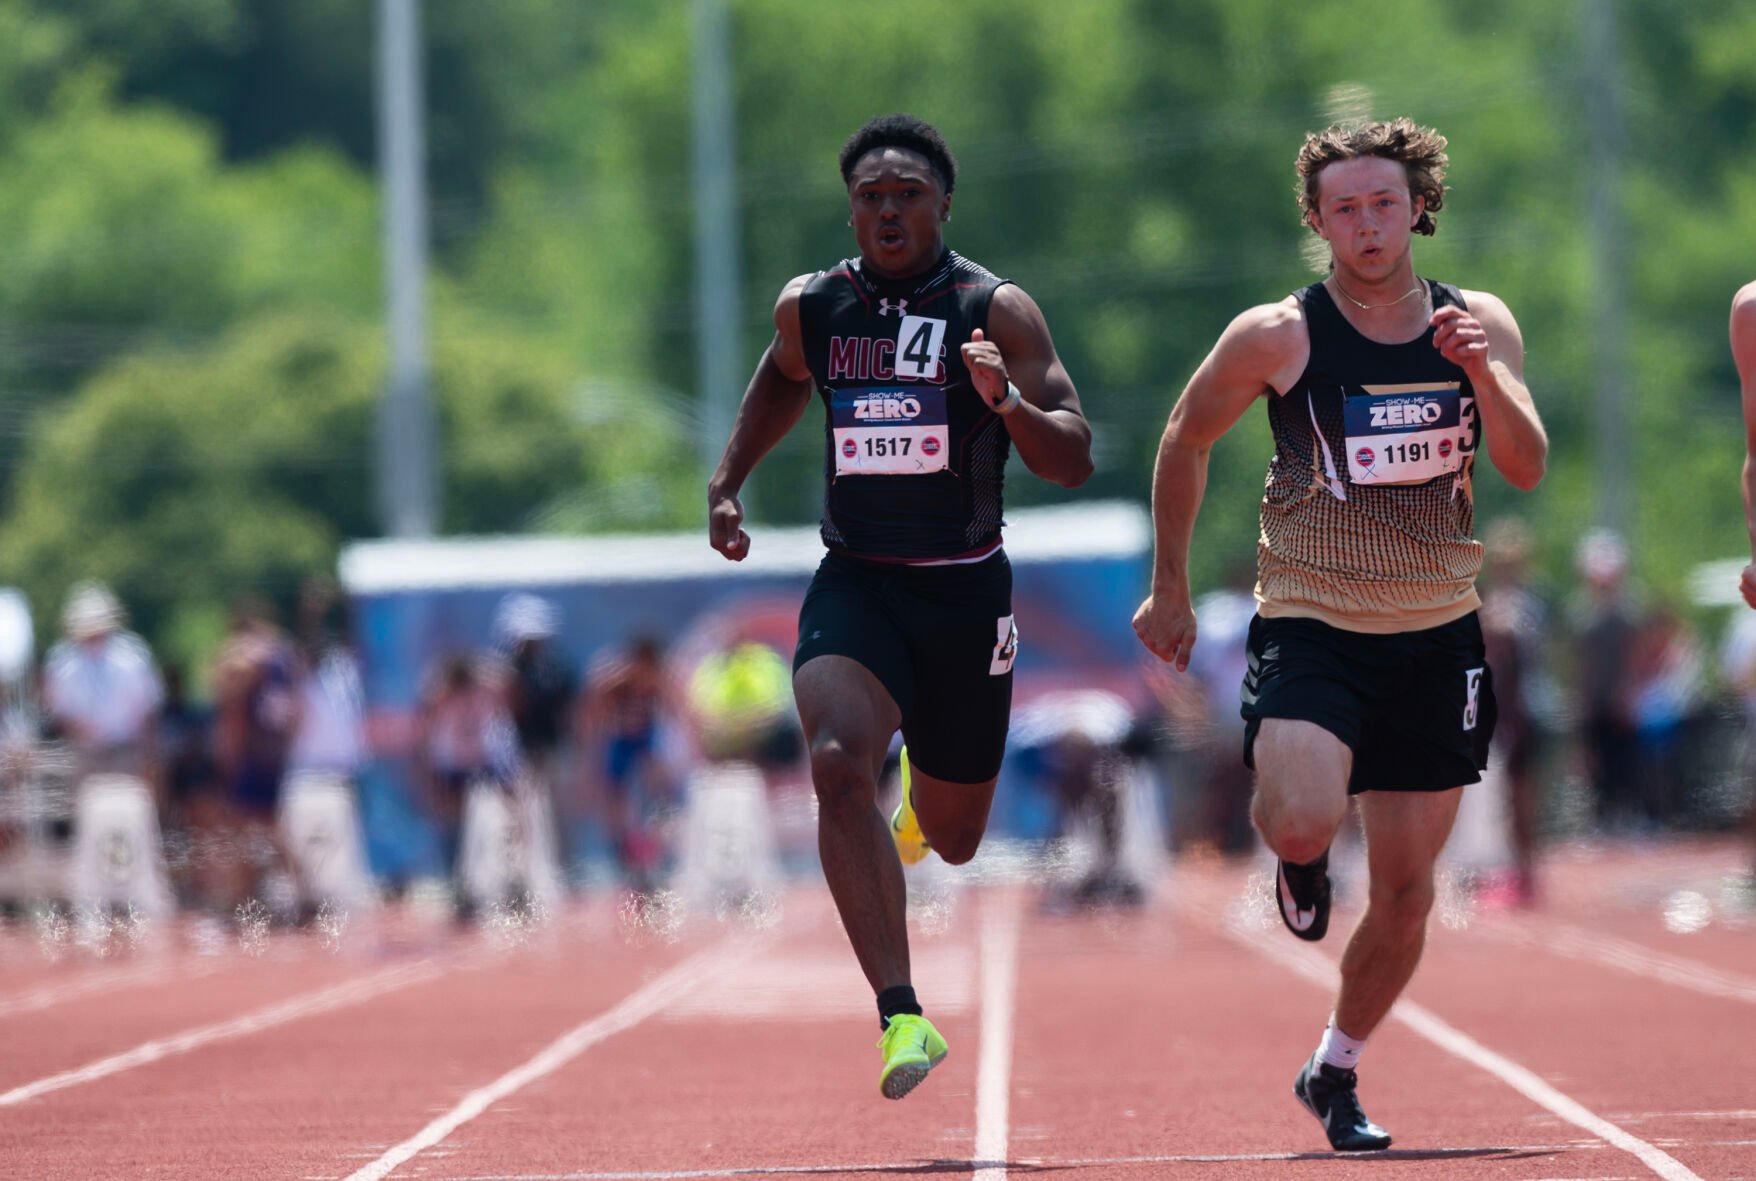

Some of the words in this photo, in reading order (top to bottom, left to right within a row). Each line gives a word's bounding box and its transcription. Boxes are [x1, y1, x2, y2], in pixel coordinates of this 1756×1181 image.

[903, 321, 934, 374] 4
[828, 336, 947, 384] MIC
[868, 391, 905, 400] SHOW-ME
[1386, 396, 1425, 406] SHOW-ME
[853, 398, 921, 419] ZERO
[1369, 402, 1442, 427] ZERO
[1458, 402, 1474, 453] 3
[864, 437, 912, 457] 1517
[1384, 441, 1430, 464] 1191
